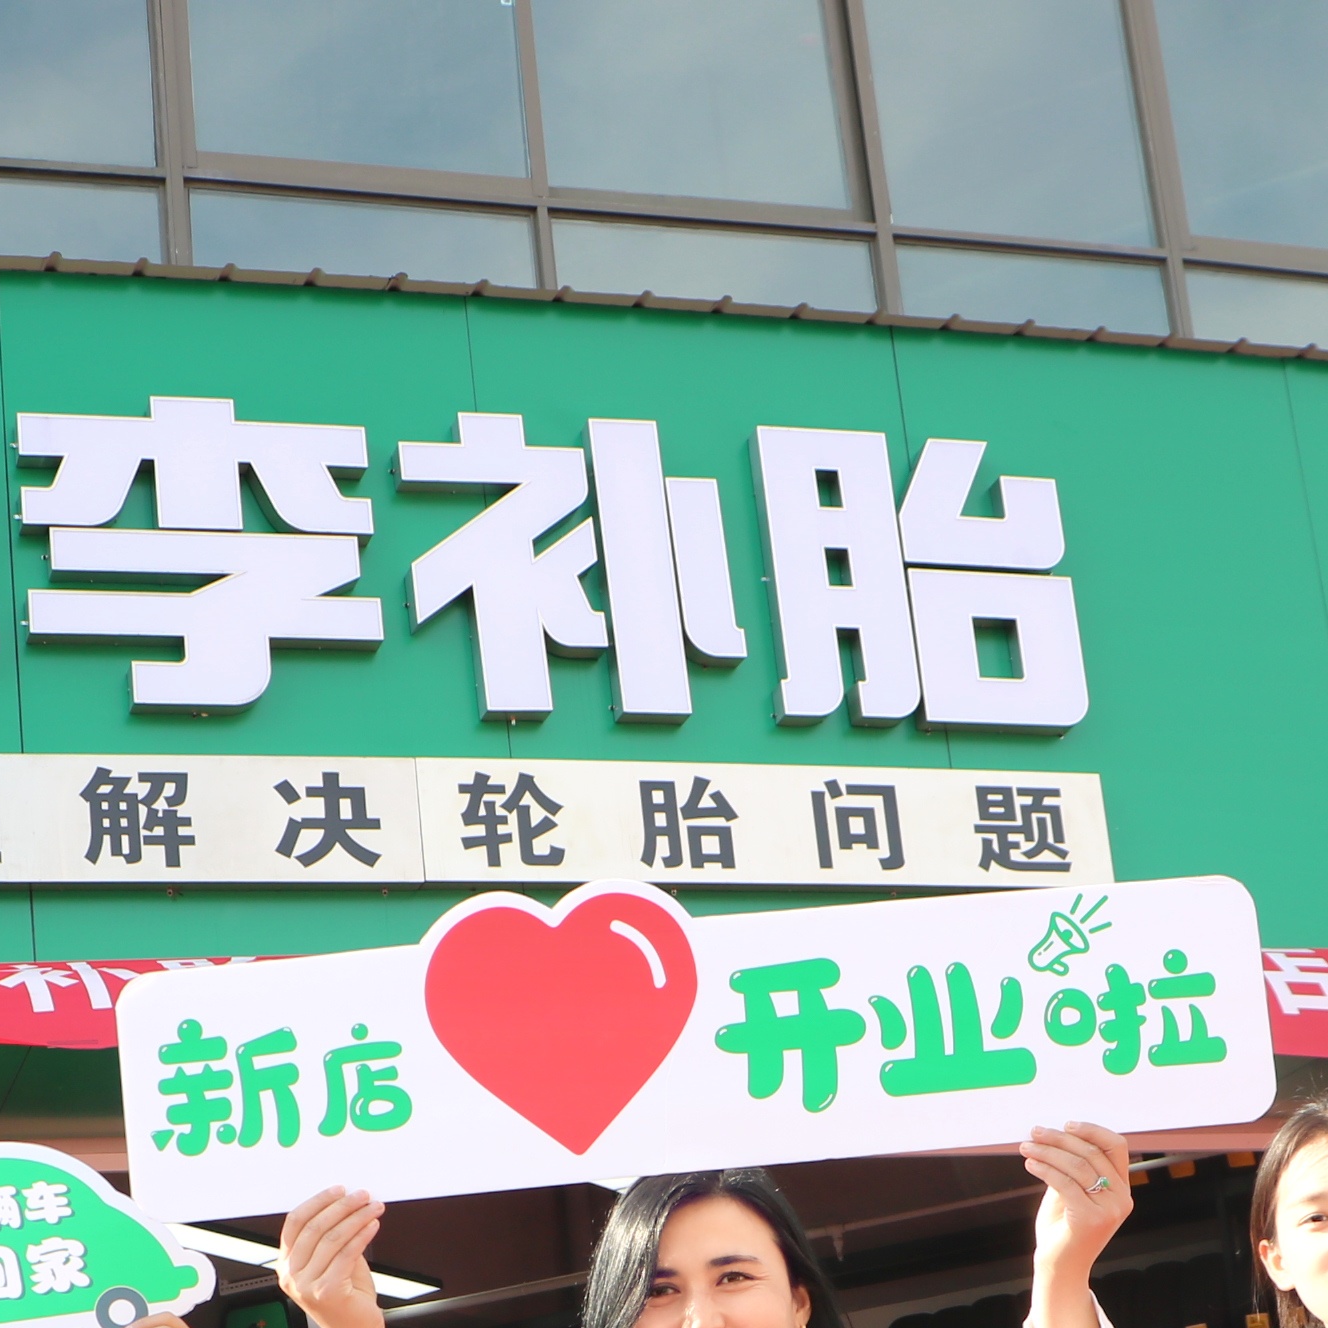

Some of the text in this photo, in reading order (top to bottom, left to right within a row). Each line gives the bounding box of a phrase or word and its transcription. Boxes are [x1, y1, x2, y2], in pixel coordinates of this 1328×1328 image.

[151, 949, 1228, 1157] 新店 开业啦
